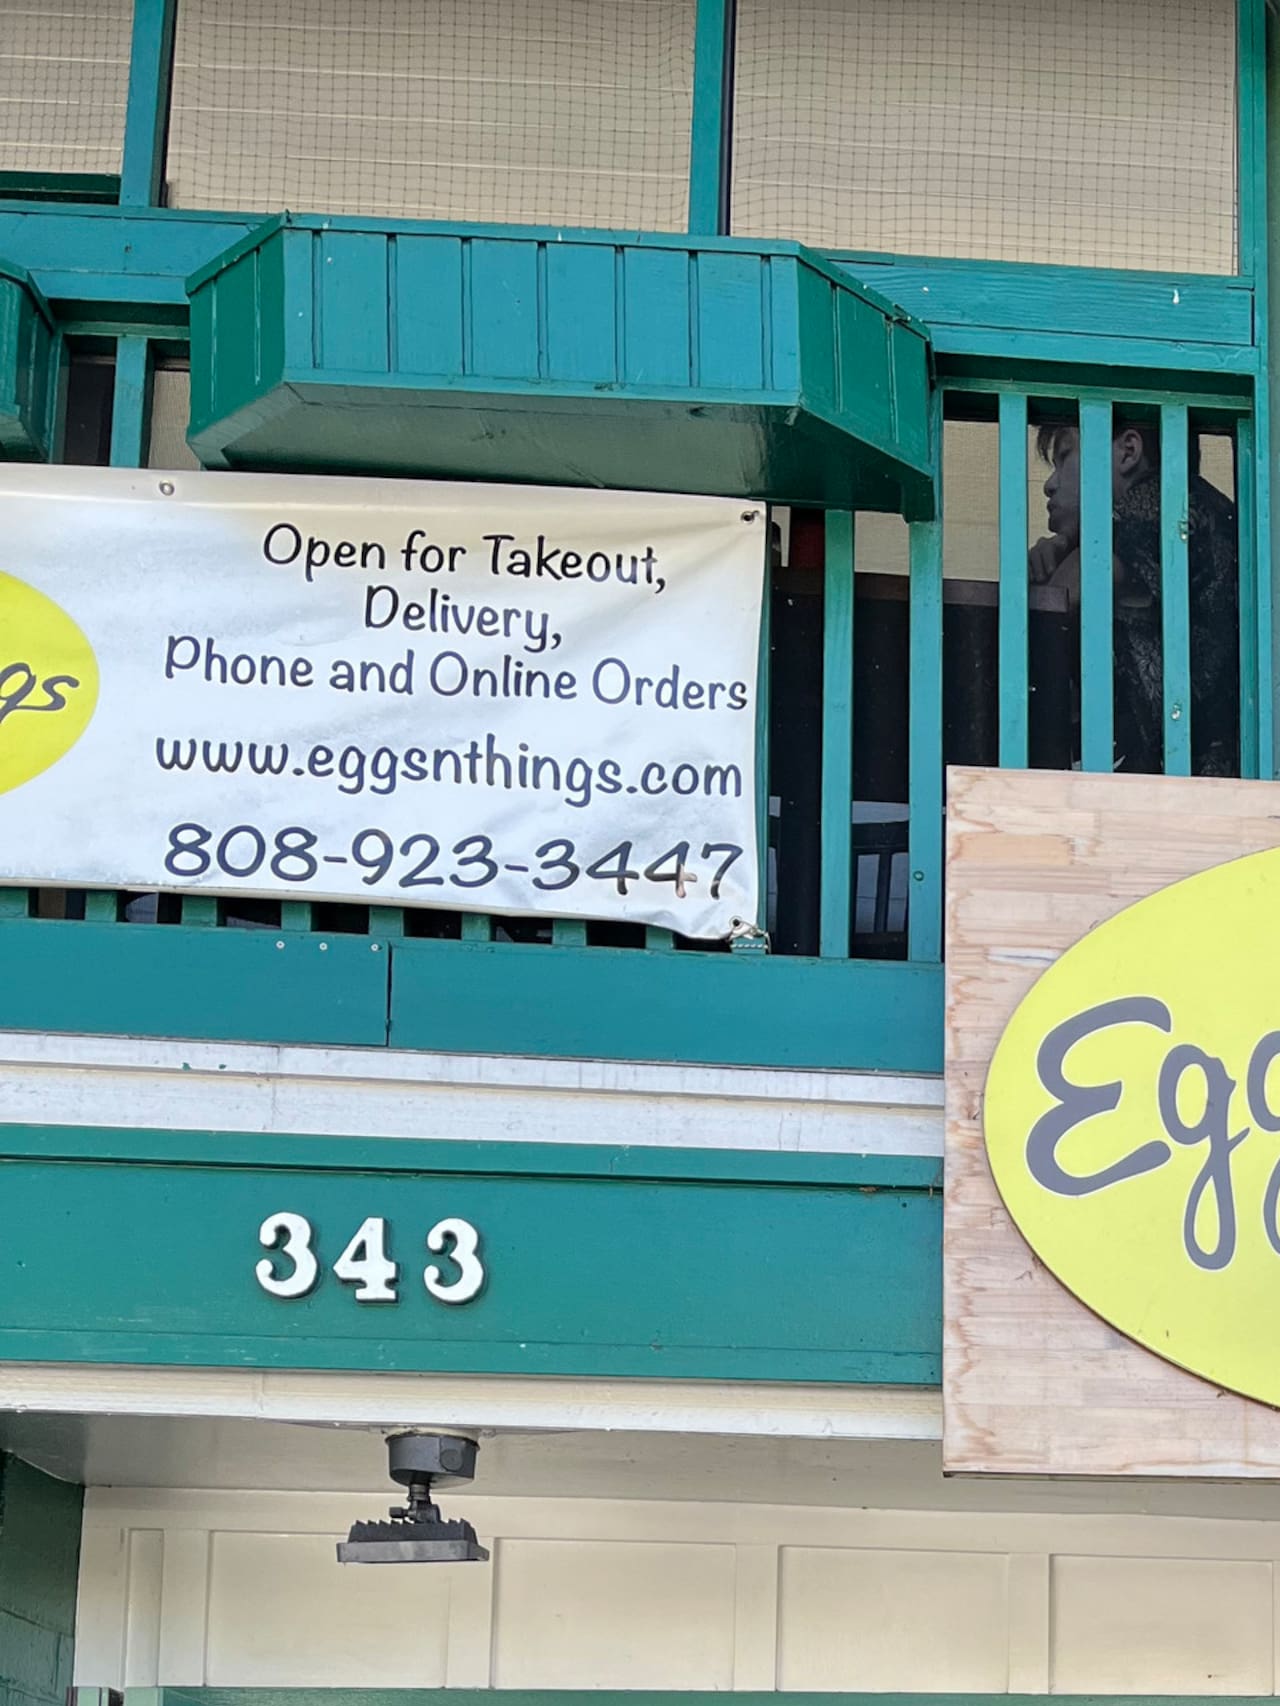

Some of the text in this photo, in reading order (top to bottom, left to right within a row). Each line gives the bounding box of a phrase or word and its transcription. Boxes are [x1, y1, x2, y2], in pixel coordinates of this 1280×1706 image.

[262, 522, 667, 594] Open for Takeout,
[364, 585, 563, 650] Delivery,
[164, 634, 749, 712] Phone and Online Orders
[156, 733, 743, 808] www.eggsnthings.com
[164, 822, 744, 900] 808-923-3447
[255, 1211, 485, 1304] 343
